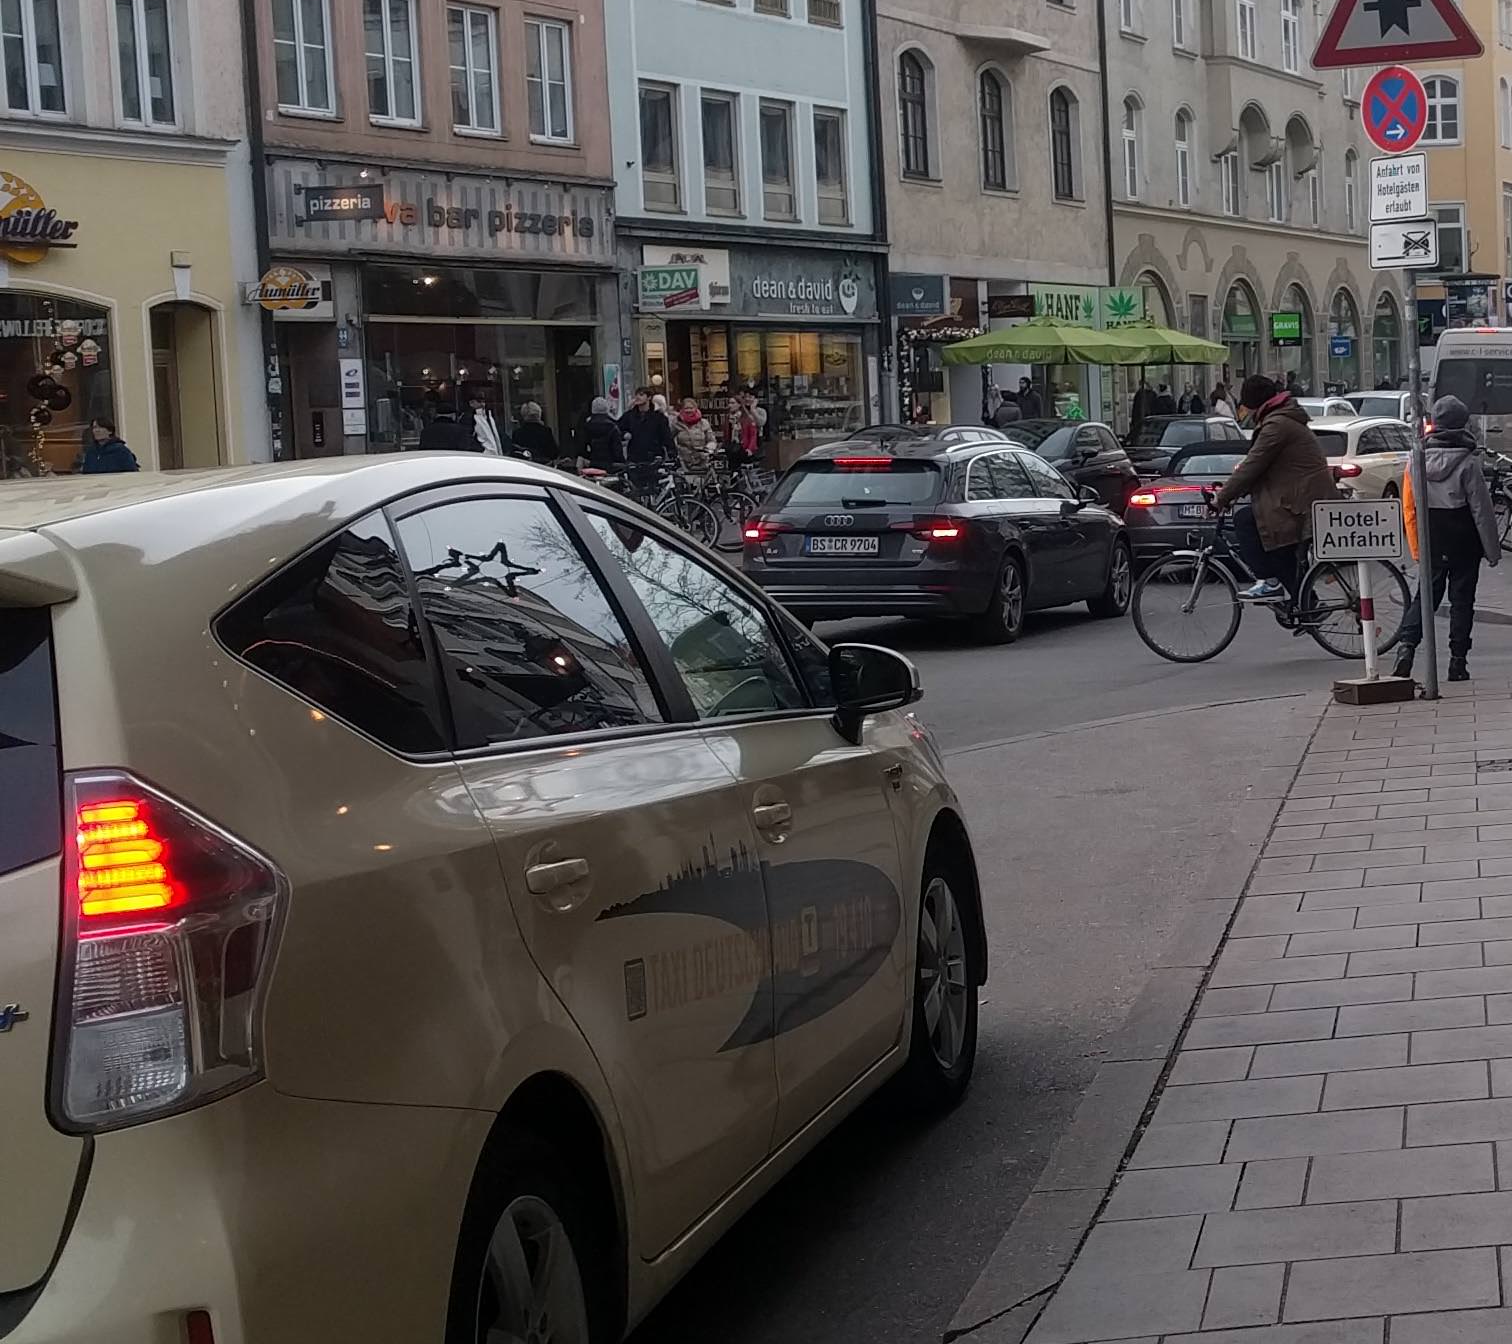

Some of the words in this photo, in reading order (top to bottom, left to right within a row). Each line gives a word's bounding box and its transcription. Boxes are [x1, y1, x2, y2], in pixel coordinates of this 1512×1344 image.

[1376, 165, 1403, 178] Anfahrt
[1407, 163, 1420, 175] von
[1377, 181, 1420, 198] Hotelgästen
[309, 194, 371, 215] pizzeria
[1385, 199, 1412, 214] erlaubt
[427, 197, 479, 230] bar
[488, 203, 595, 238] pizzeria
[658, 271, 697, 289] DAV
[752, 275, 785, 298] dean
[788, 280, 796, 299] &
[798, 277, 833, 301] david
[1044, 293, 1080, 321] HANF
[1273, 321, 1300, 330] GRAVIS
[1329, 510, 1388, 528] Hotel-
[812, 538, 826, 551] BS
[834, 538, 848, 551] CR
[850, 537, 877, 550] 9704
[1322, 531, 1396, 548] Anfahrt
